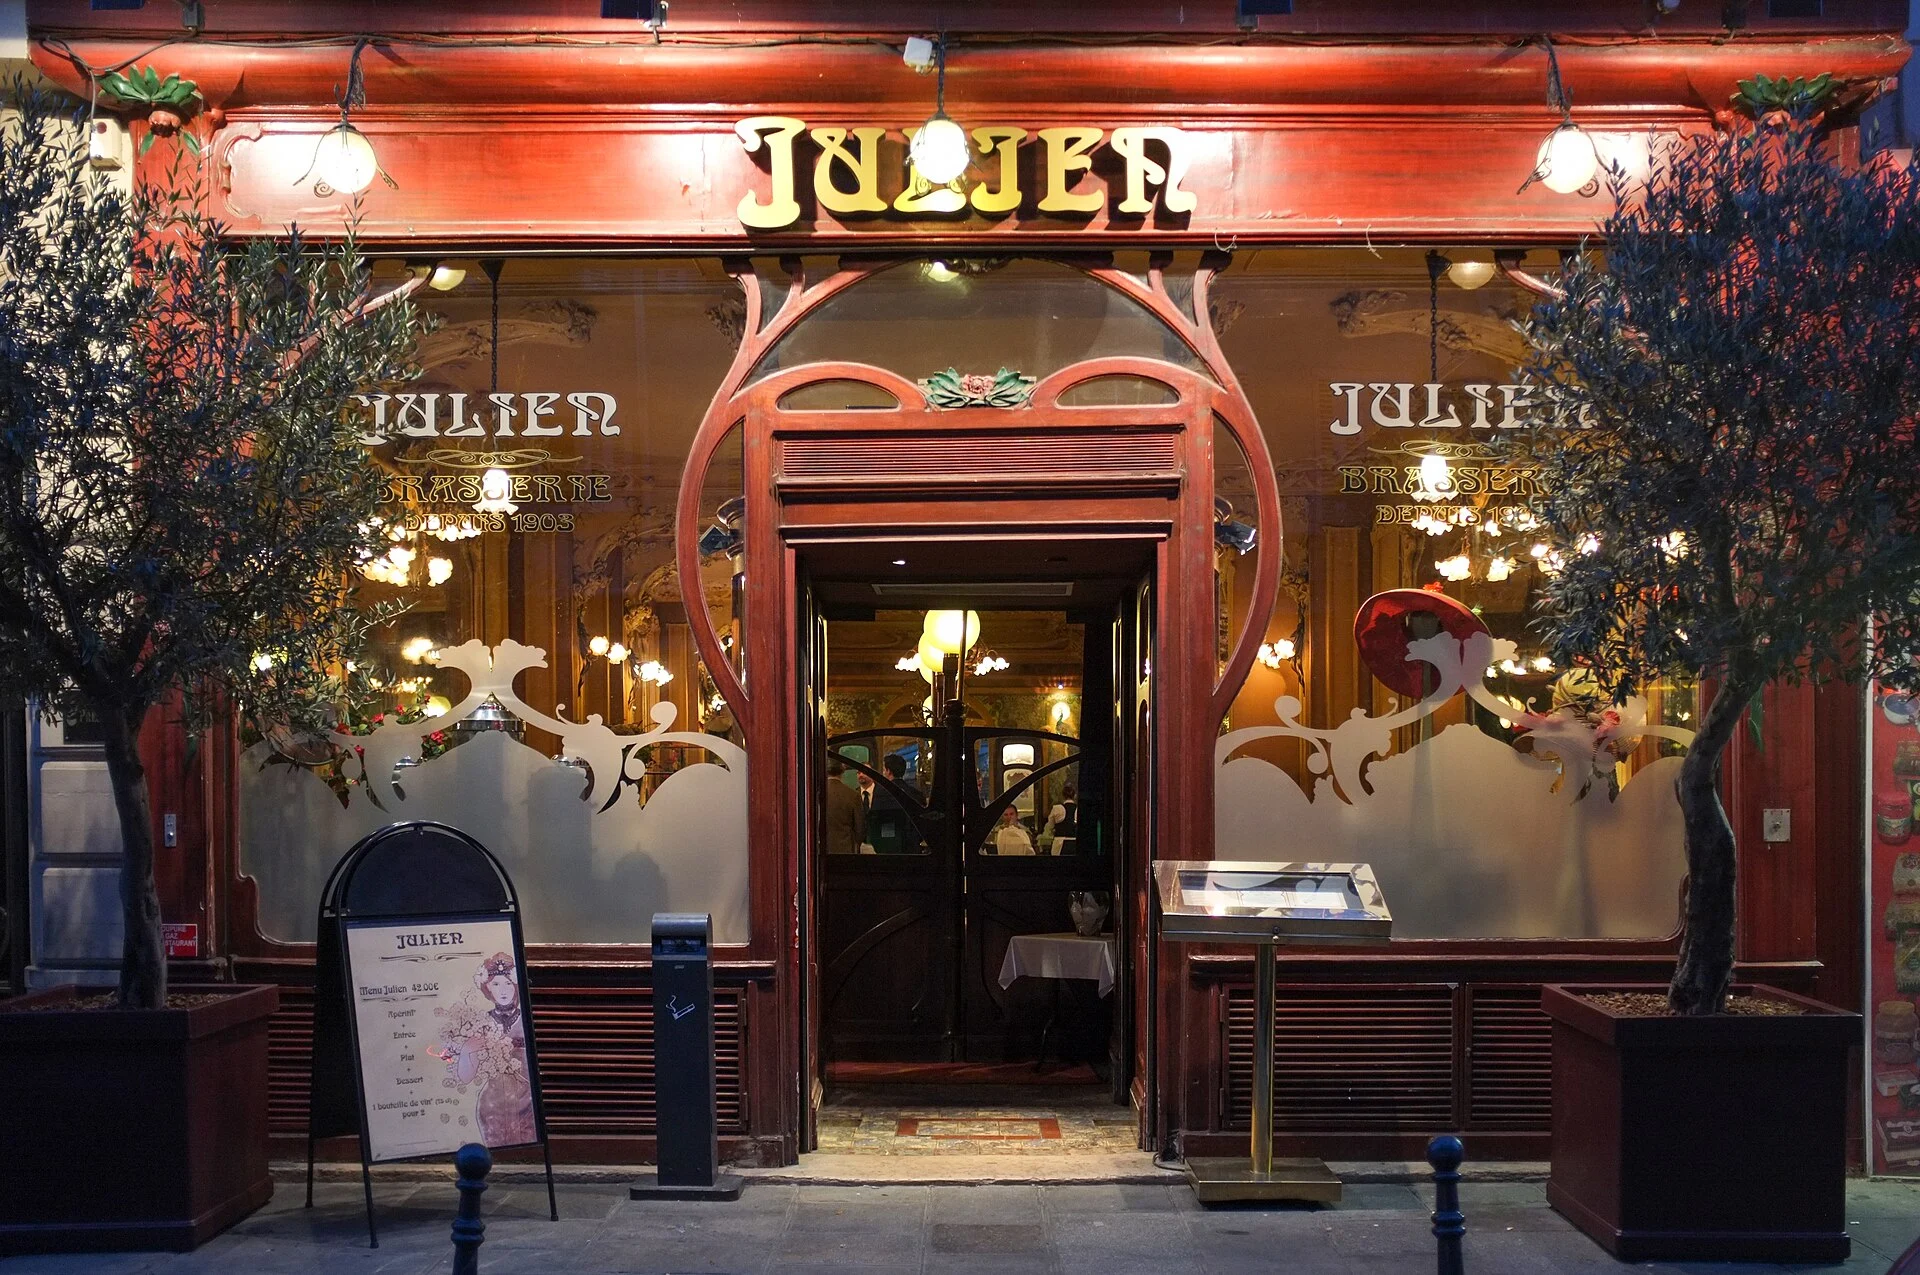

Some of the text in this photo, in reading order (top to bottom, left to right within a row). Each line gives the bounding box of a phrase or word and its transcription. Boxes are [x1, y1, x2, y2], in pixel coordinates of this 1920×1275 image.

[734, 116, 1197, 229] JULIEN
[349, 392, 621, 446] JULIEN
[1338, 466, 1546, 496] BRASSER
[1375, 505, 1535, 528] DEPUIS 190
[405, 513, 575, 533] DEPUIS 1903
[160, 925, 187, 933] OUPURE
[164, 939, 195, 947] STAURANT
[396, 932, 464, 949] JULIEN
[359, 986, 382, 996] Menu
[383, 985, 407, 995] Julien
[400, 1054, 415, 1062] Plat
[396, 1076, 423, 1086] Dessert
[377, 1099, 408, 1111] bouteille
[409, 1099, 419, 1108] de
[402, 1110, 419, 1120] pour
